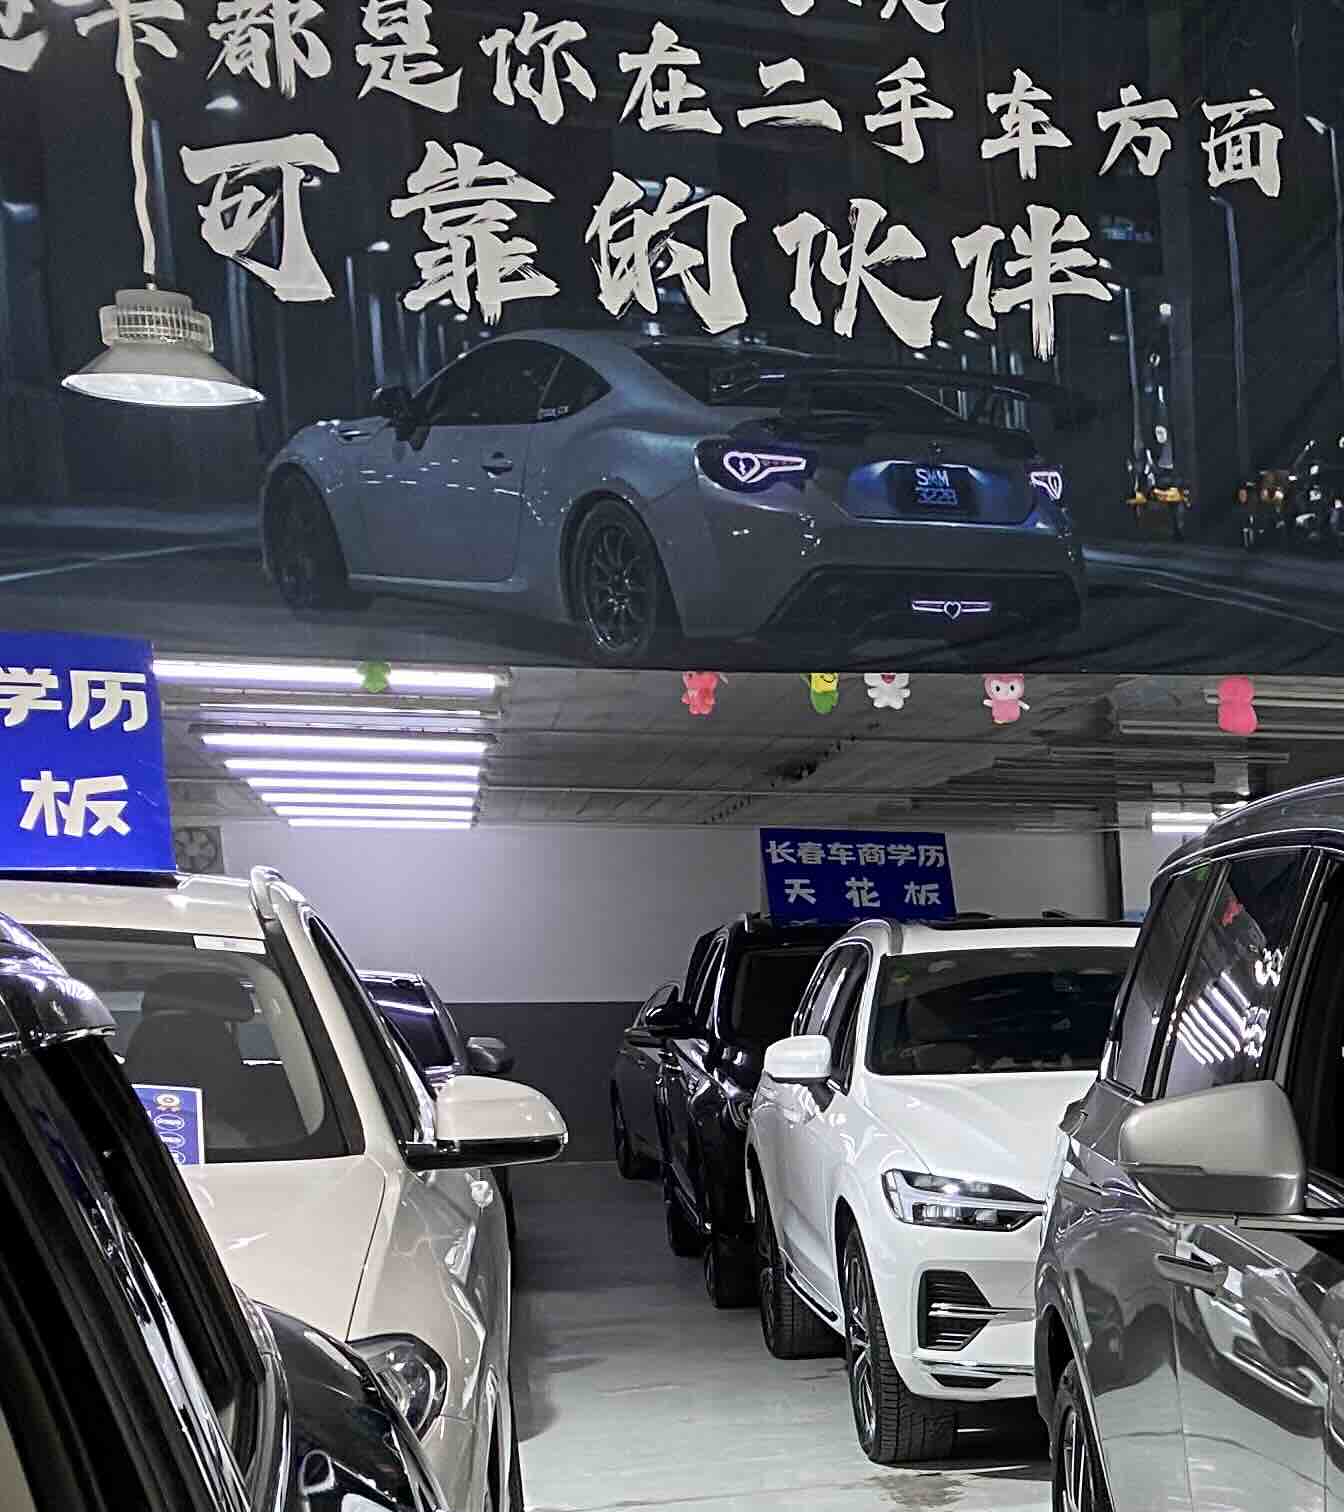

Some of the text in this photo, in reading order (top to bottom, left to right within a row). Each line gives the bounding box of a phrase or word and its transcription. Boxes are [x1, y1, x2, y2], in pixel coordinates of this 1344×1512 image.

[179, 132, 1113, 362] 可靠的伙伴
[0, 667, 149, 733] 学历
[20, 770, 130, 838] 板
[766, 840, 945, 868] 长春车商学历
[784, 876, 942, 908] 天花板
